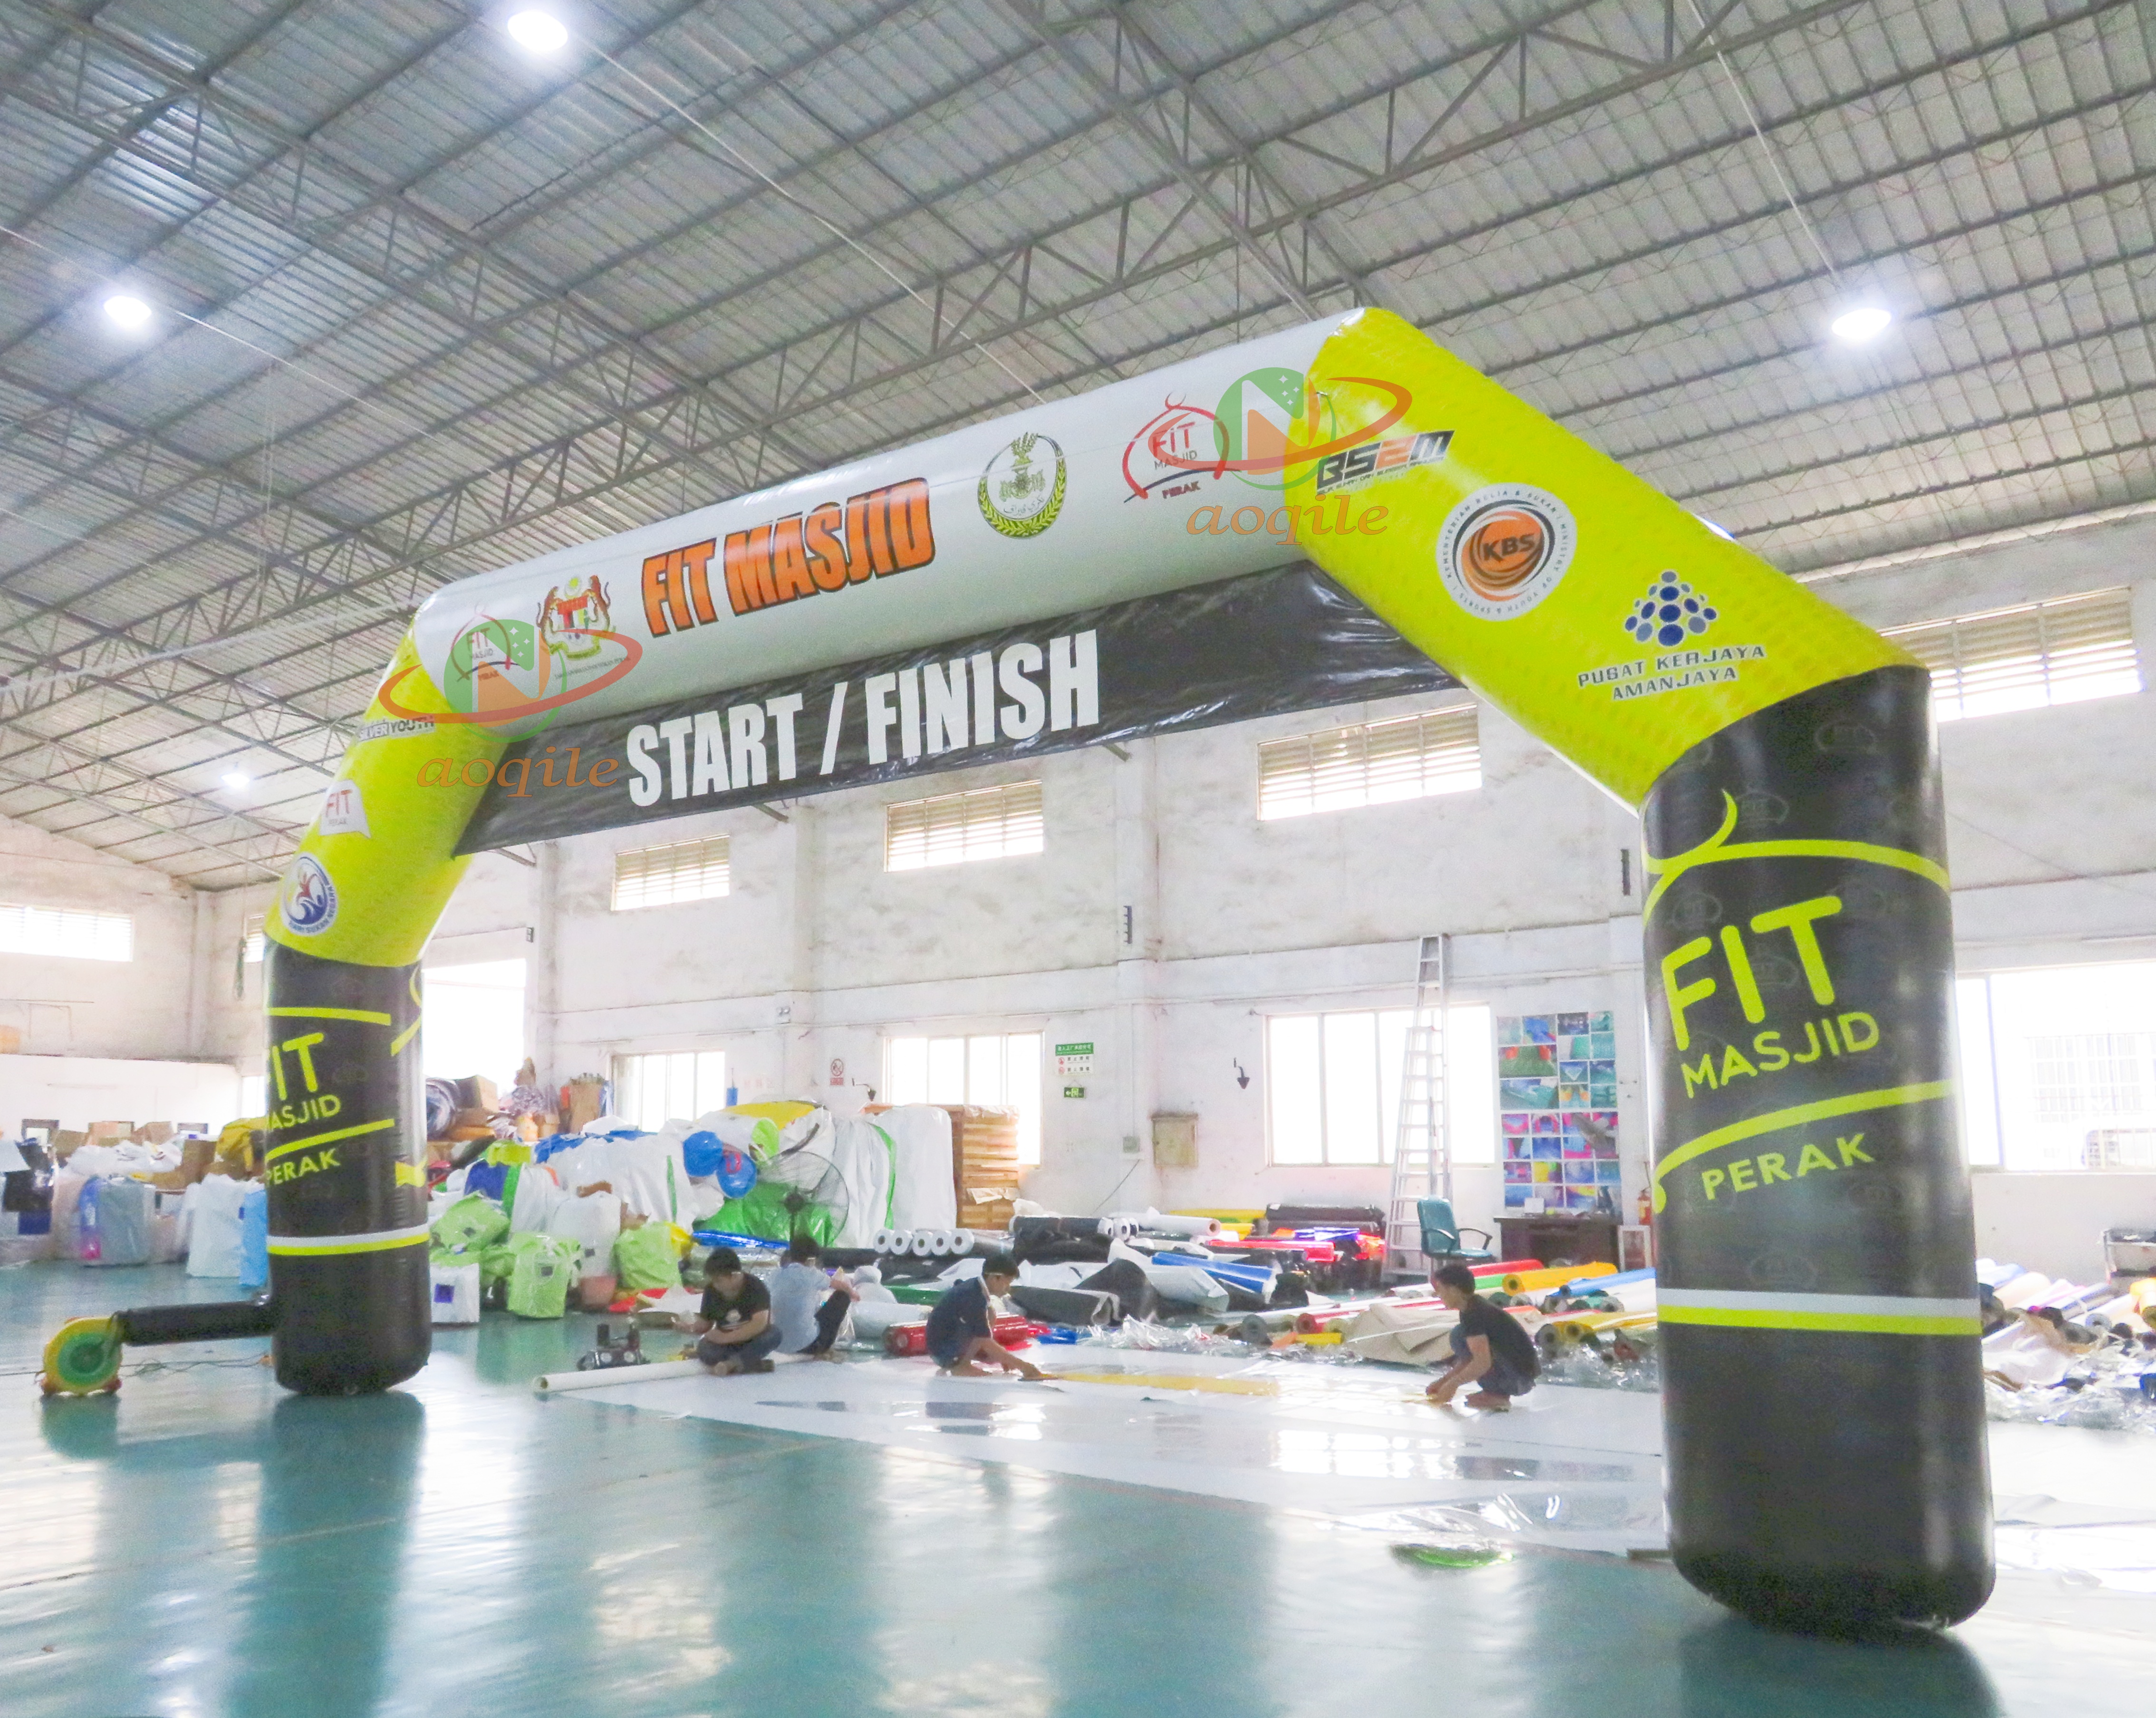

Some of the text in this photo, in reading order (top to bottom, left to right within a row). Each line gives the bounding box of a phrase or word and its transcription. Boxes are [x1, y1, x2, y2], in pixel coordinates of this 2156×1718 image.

[640, 477, 935, 637] FIT MASJID
[1482, 533, 1535, 563] KBS
[1613, 667, 1736, 700] AMANJAYA
[1656, 646, 1764, 670] KERJAYA
[626, 629, 1099, 807] START / FINISH
[1662, 895, 1842, 1051] FIT
[267, 1032, 324, 1101] IT
[1681, 1011, 1880, 1099] MASJID
[267, 1094, 341, 1132] ASJID
[1701, 1133, 1875, 1200] PERAK
